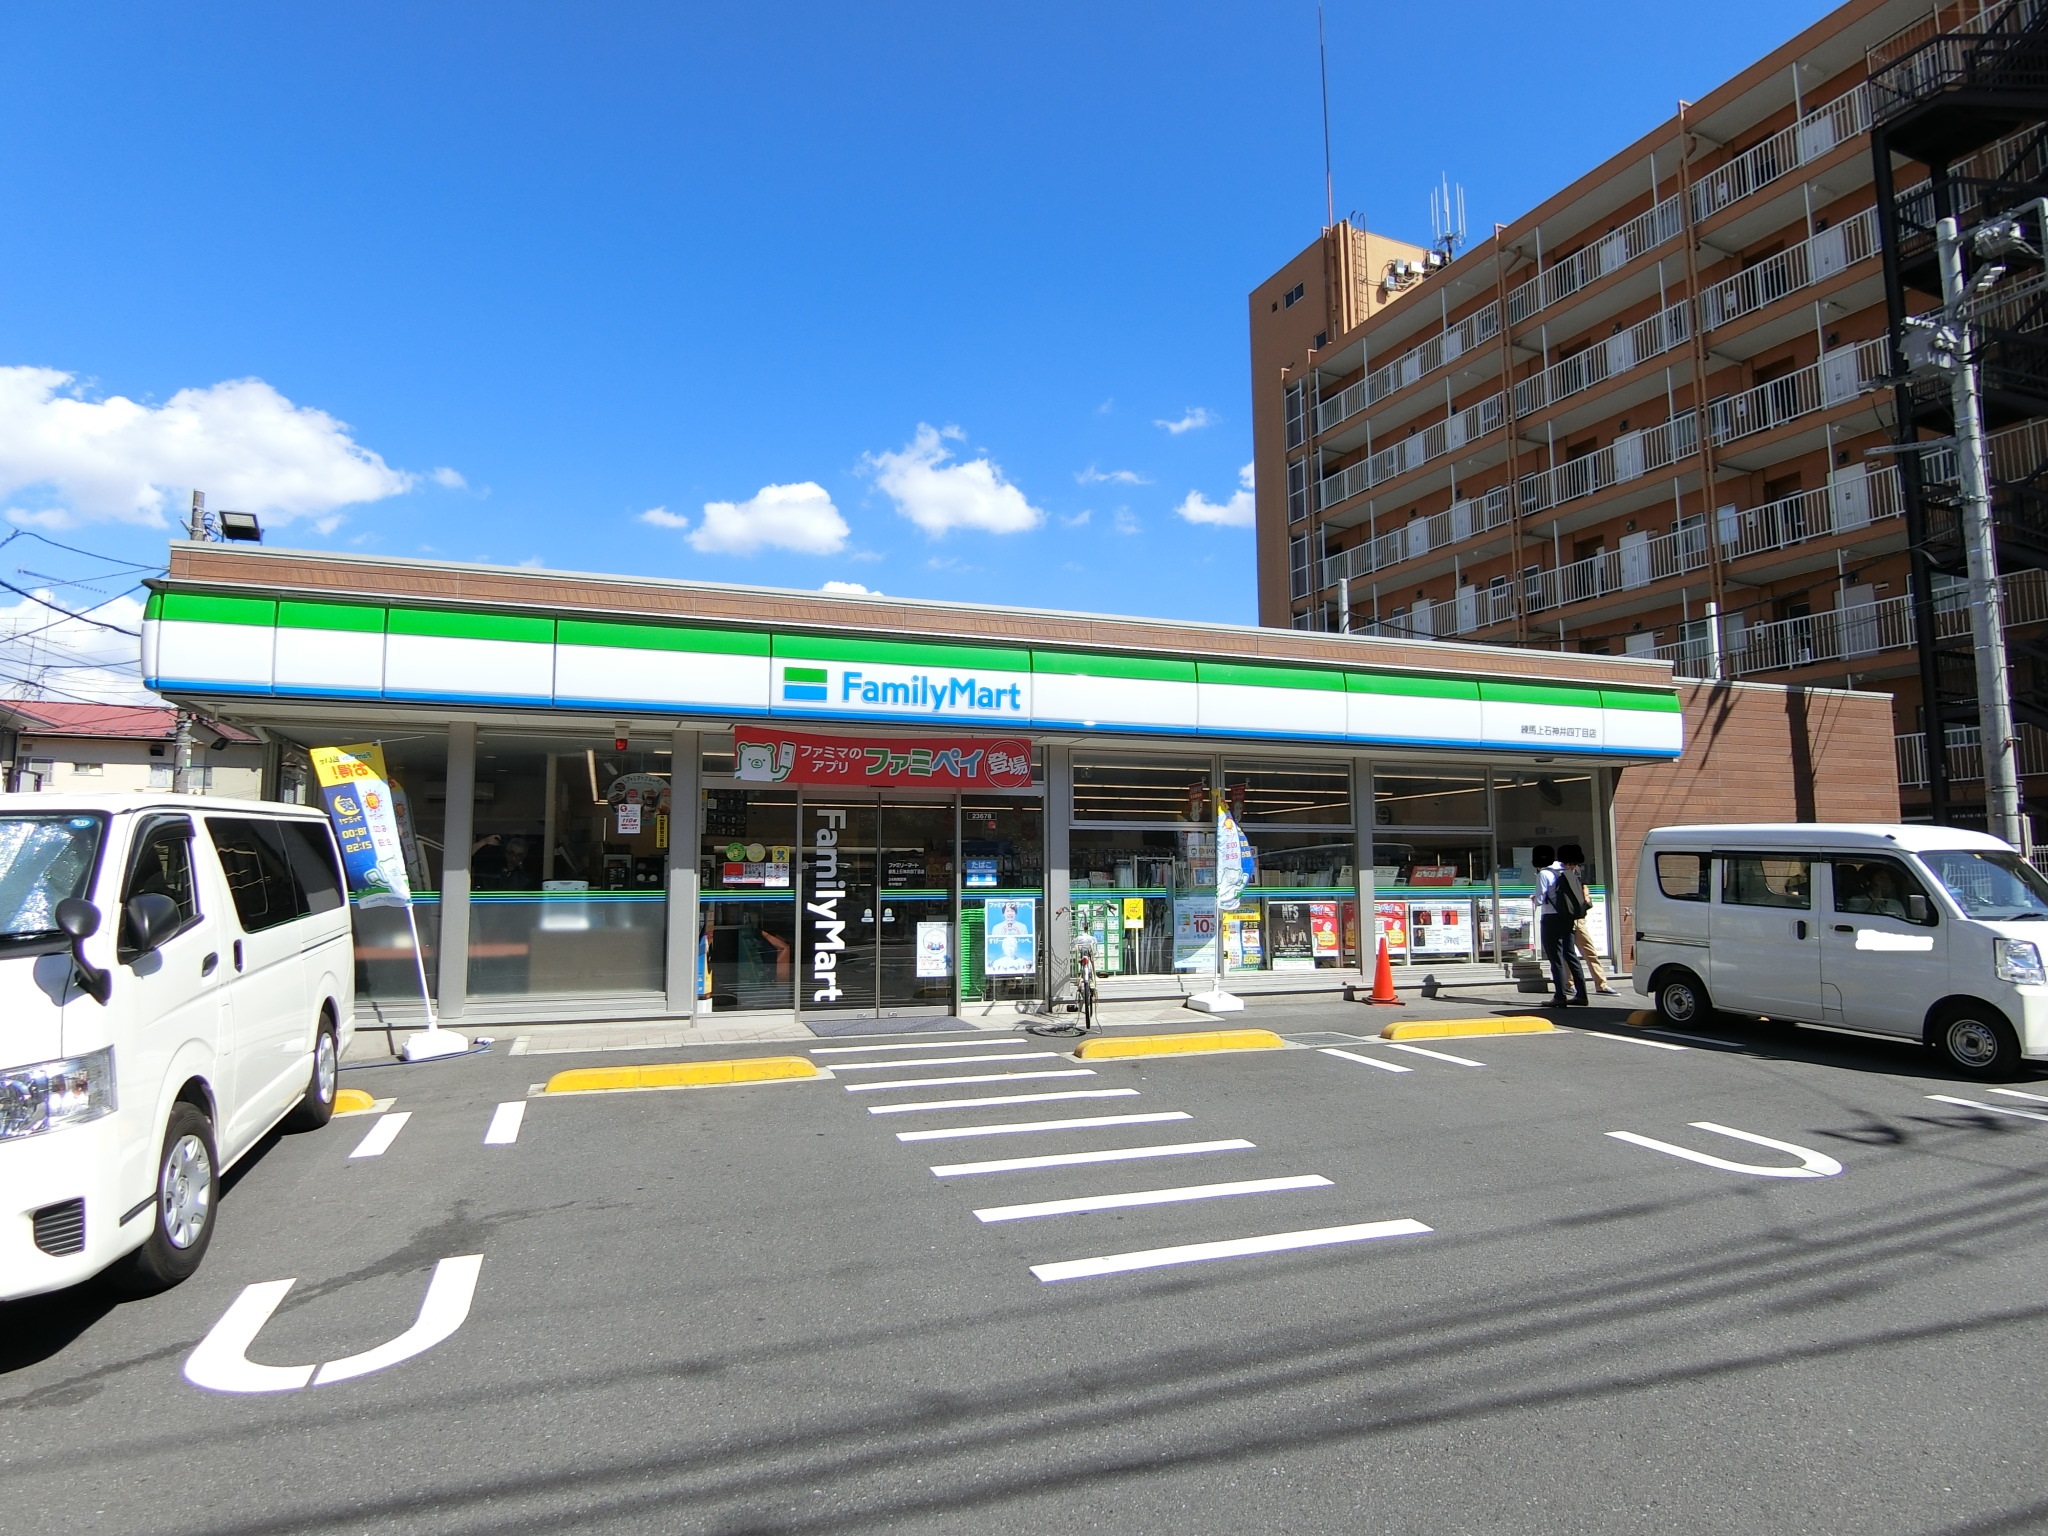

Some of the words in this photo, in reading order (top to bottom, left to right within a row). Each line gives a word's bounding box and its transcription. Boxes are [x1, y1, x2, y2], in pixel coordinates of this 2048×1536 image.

[843, 671, 1021, 711] FamilyMart
[1520, 724, 1597, 738] 練馬上石神井四丁目店
[799, 745, 862, 760] ファミマの
[863, 747, 984, 778] ファミペイ
[812, 760, 849, 774] アプリ
[988, 752, 1029, 777] 登場
[971, 861, 993, 869] たばこ
[807, 809, 846, 1001] FamilyMart
